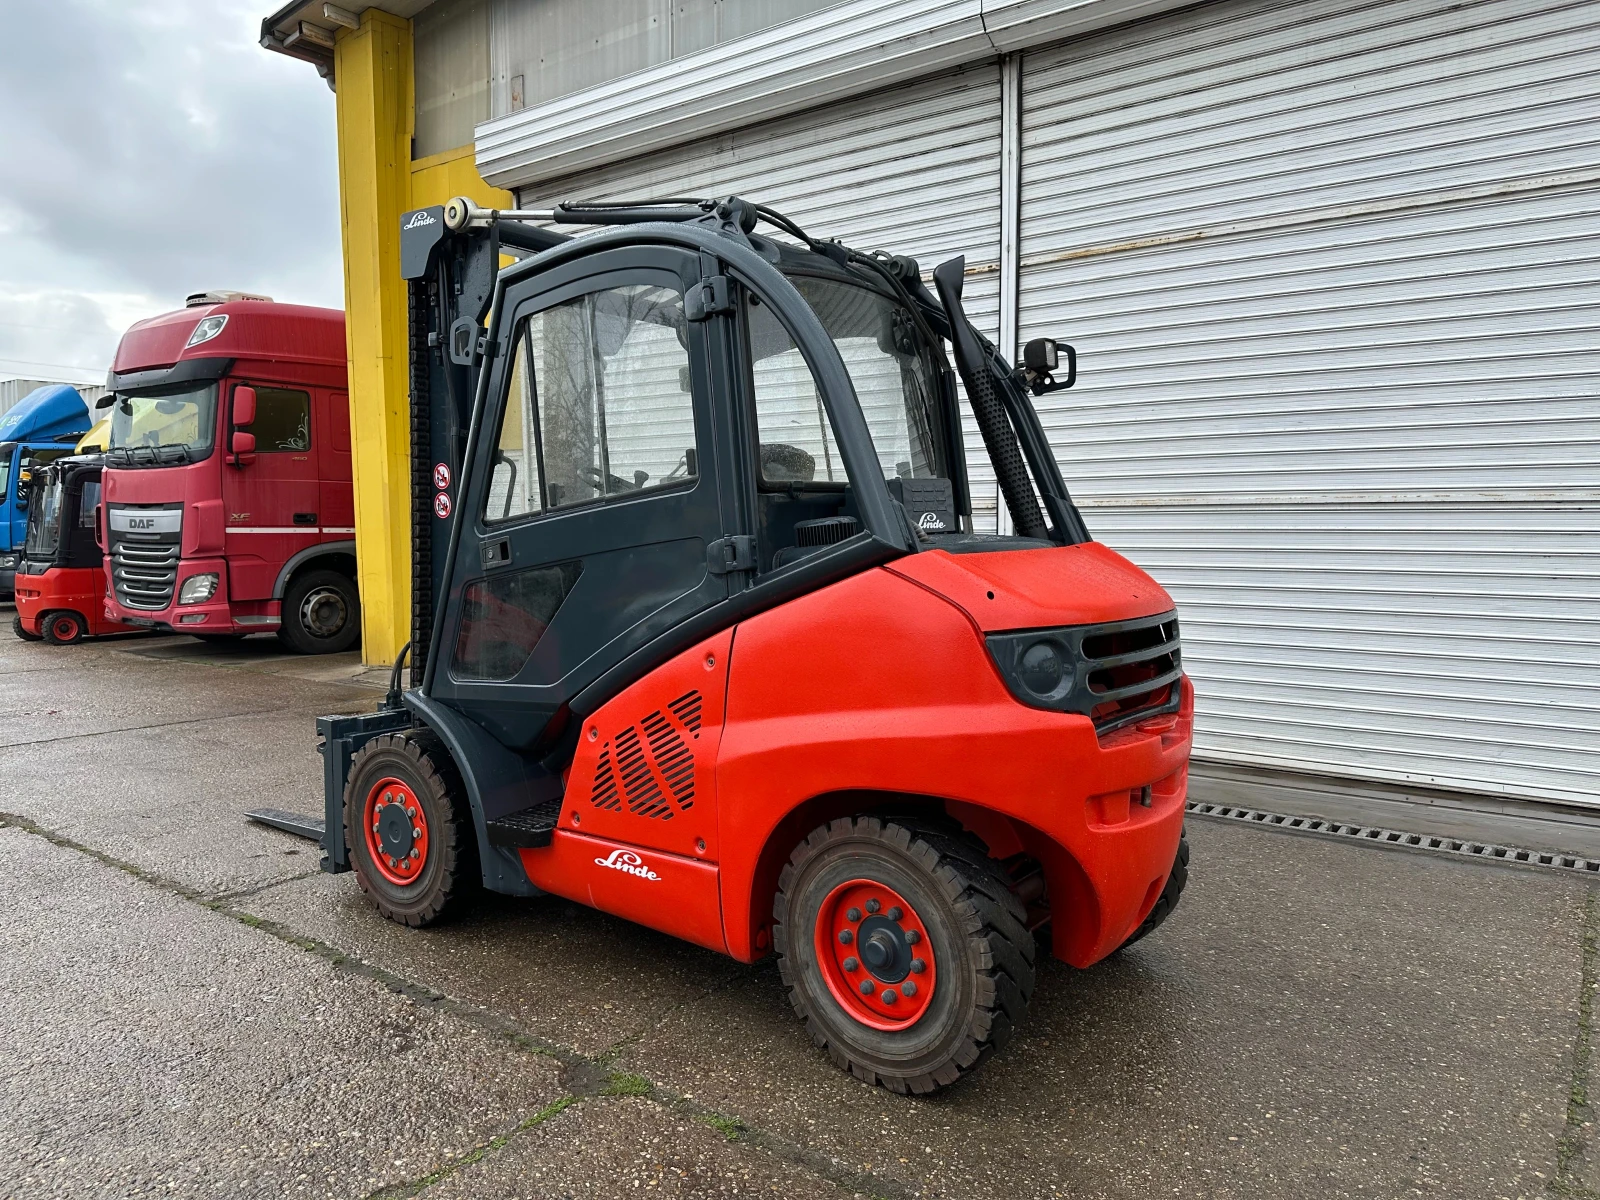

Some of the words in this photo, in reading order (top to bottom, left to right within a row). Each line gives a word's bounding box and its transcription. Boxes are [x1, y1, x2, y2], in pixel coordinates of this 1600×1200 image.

[403, 211, 437, 230] Linde
[129, 518, 154, 529] DAF
[918, 512, 946, 529] Linde
[594, 849, 662, 881] Linde
